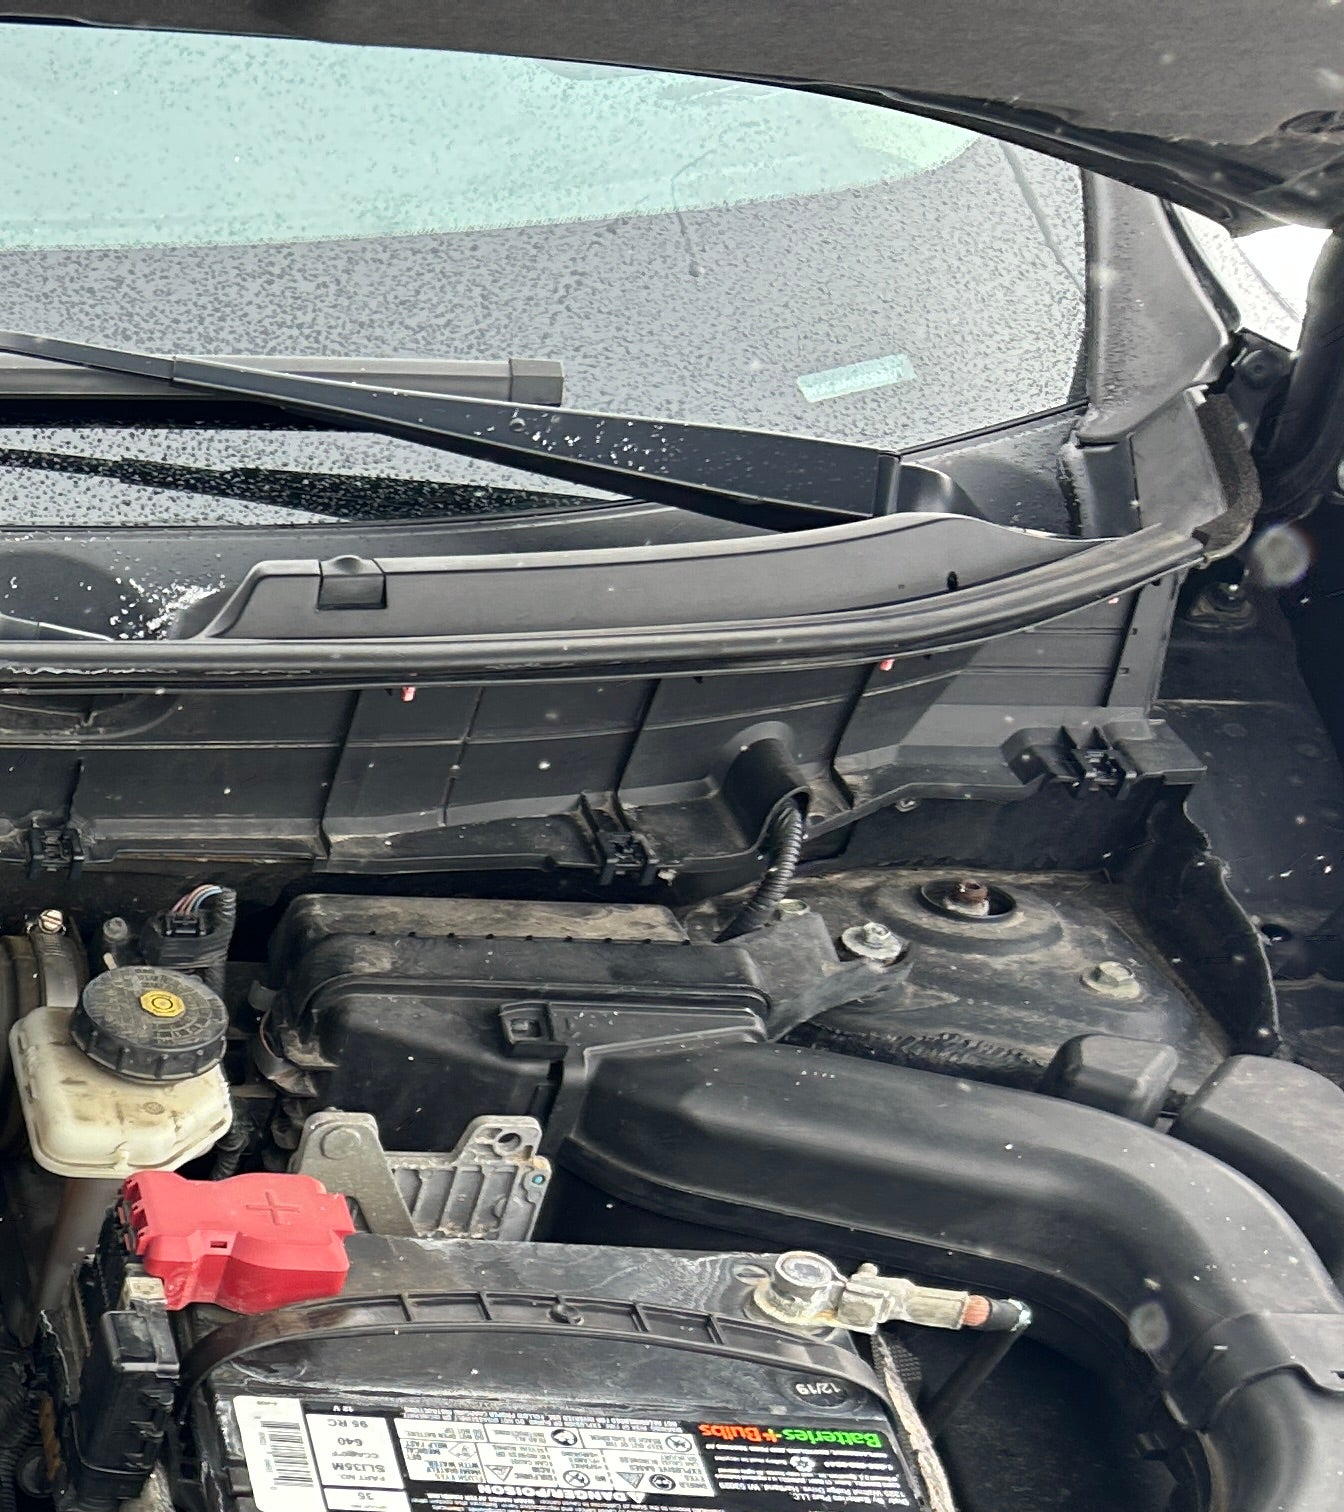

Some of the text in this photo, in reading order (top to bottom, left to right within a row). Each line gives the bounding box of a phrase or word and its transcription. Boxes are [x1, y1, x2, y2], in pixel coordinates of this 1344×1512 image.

[795, 1382, 842, 1396] 12/19
[327, 1418, 348, 1428] RC
[337, 1437, 363, 1447] 640
[331, 1463, 386, 1473] SLI35M
[477, 1484, 629, 1502] DANGER/POISON
